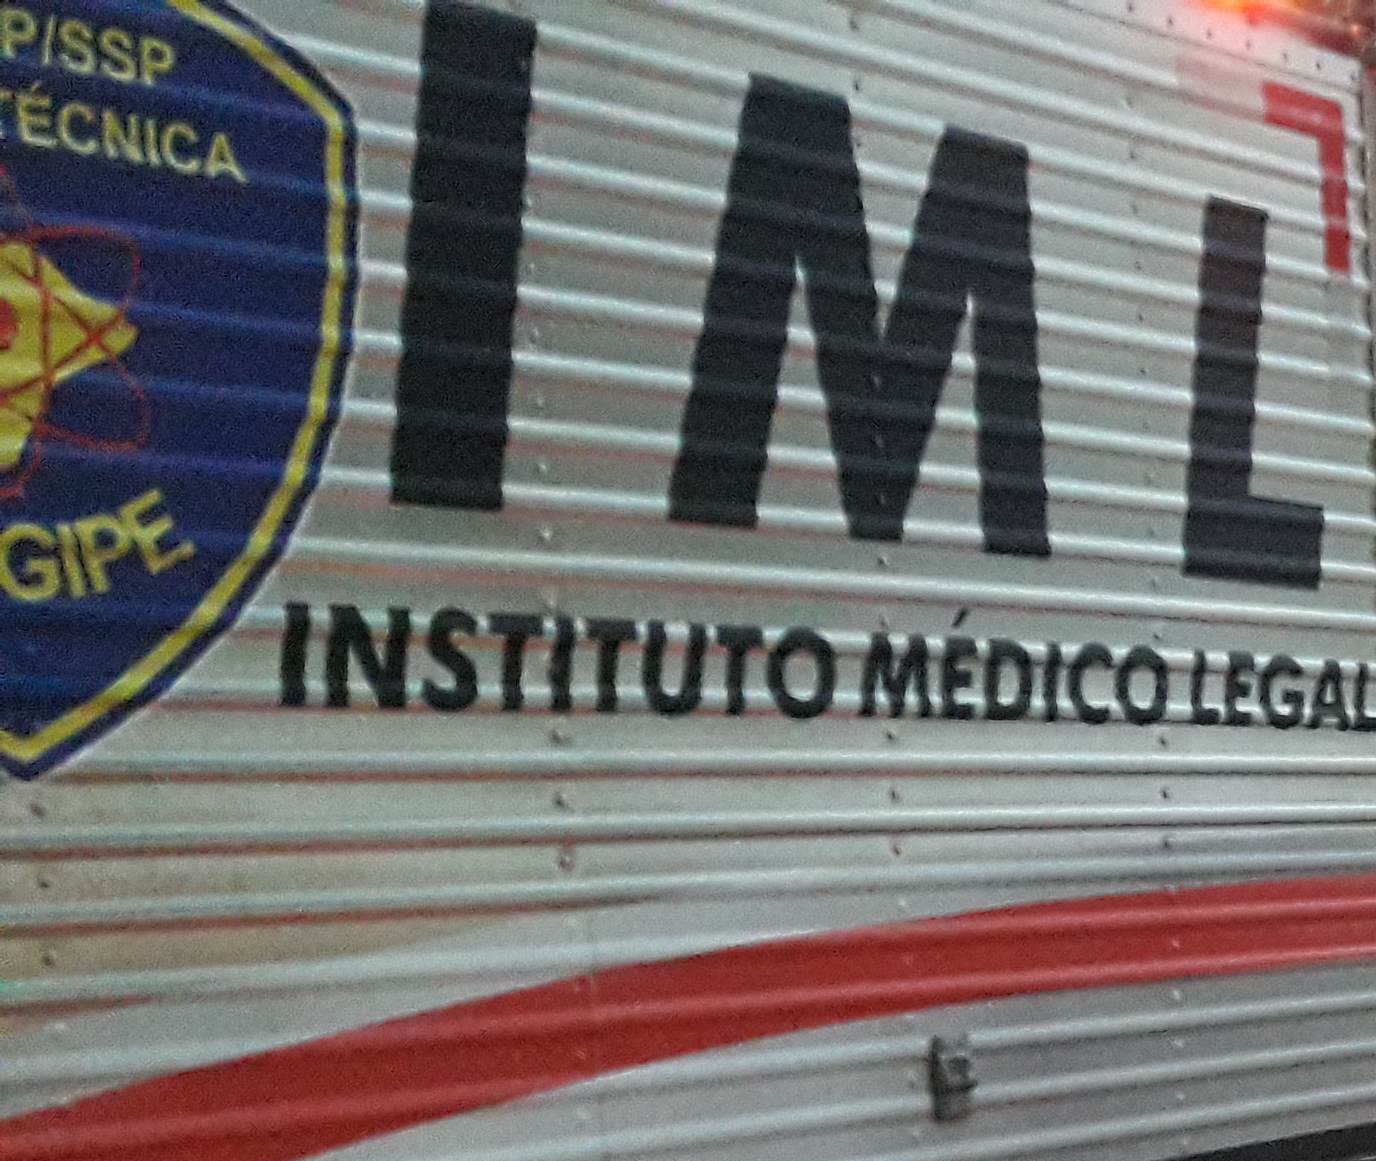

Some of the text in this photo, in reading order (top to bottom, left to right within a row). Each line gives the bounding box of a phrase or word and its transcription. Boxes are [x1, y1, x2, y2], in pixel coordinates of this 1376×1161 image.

[390, 0, 1325, 588] IML
[0, 488, 194, 600] GIPE
[280, 600, 837, 719] INSTITUTO
[858, 607, 1168, 725] MÉDICO
